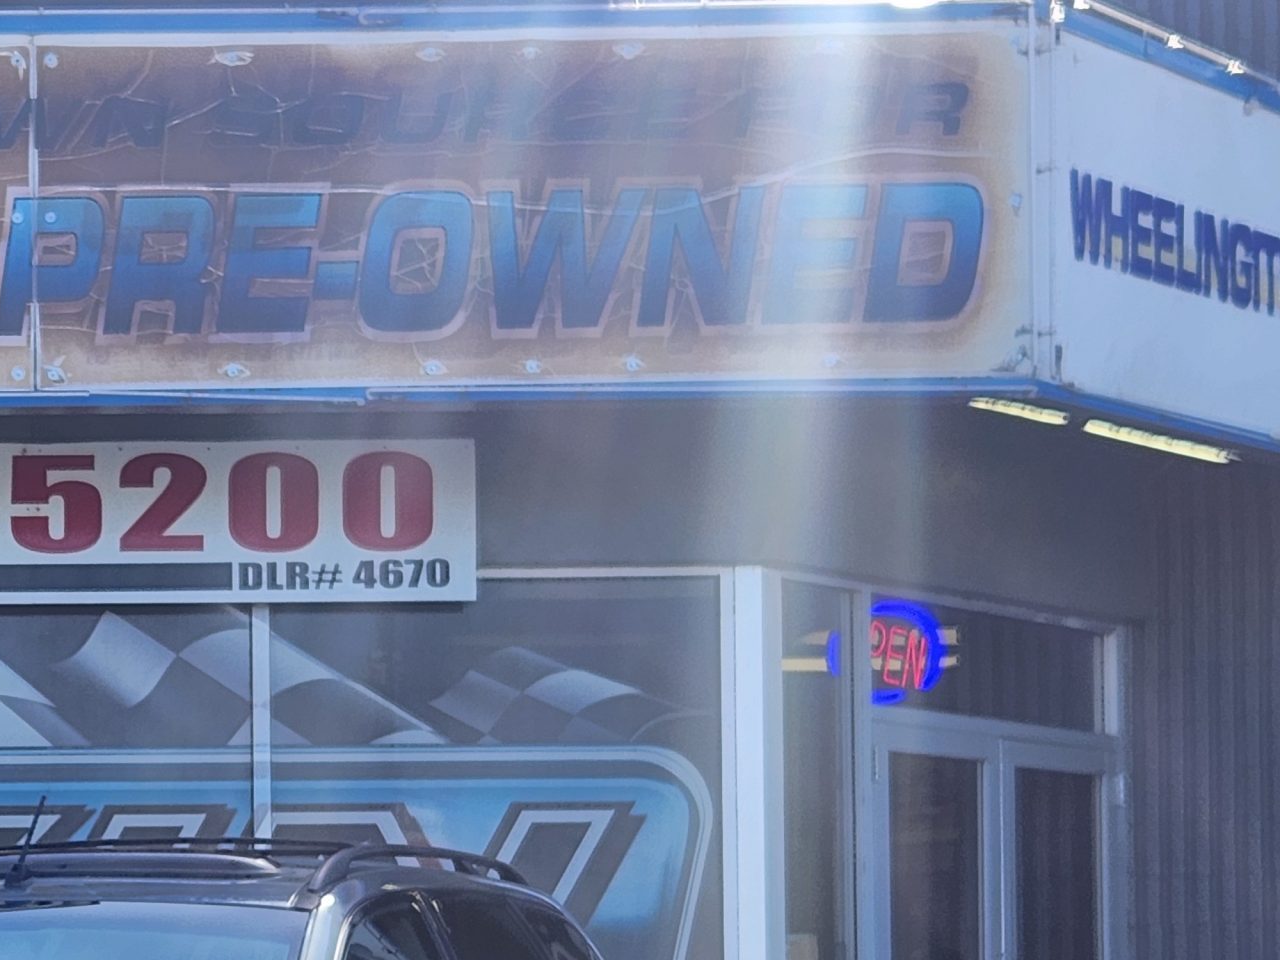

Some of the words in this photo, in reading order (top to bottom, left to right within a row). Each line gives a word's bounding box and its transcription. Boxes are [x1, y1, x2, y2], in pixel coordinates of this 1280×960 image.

[238, 561, 344, 591] DLR#
[351, 558, 451, 590] 4670
[869, 620, 928, 690] PEN
